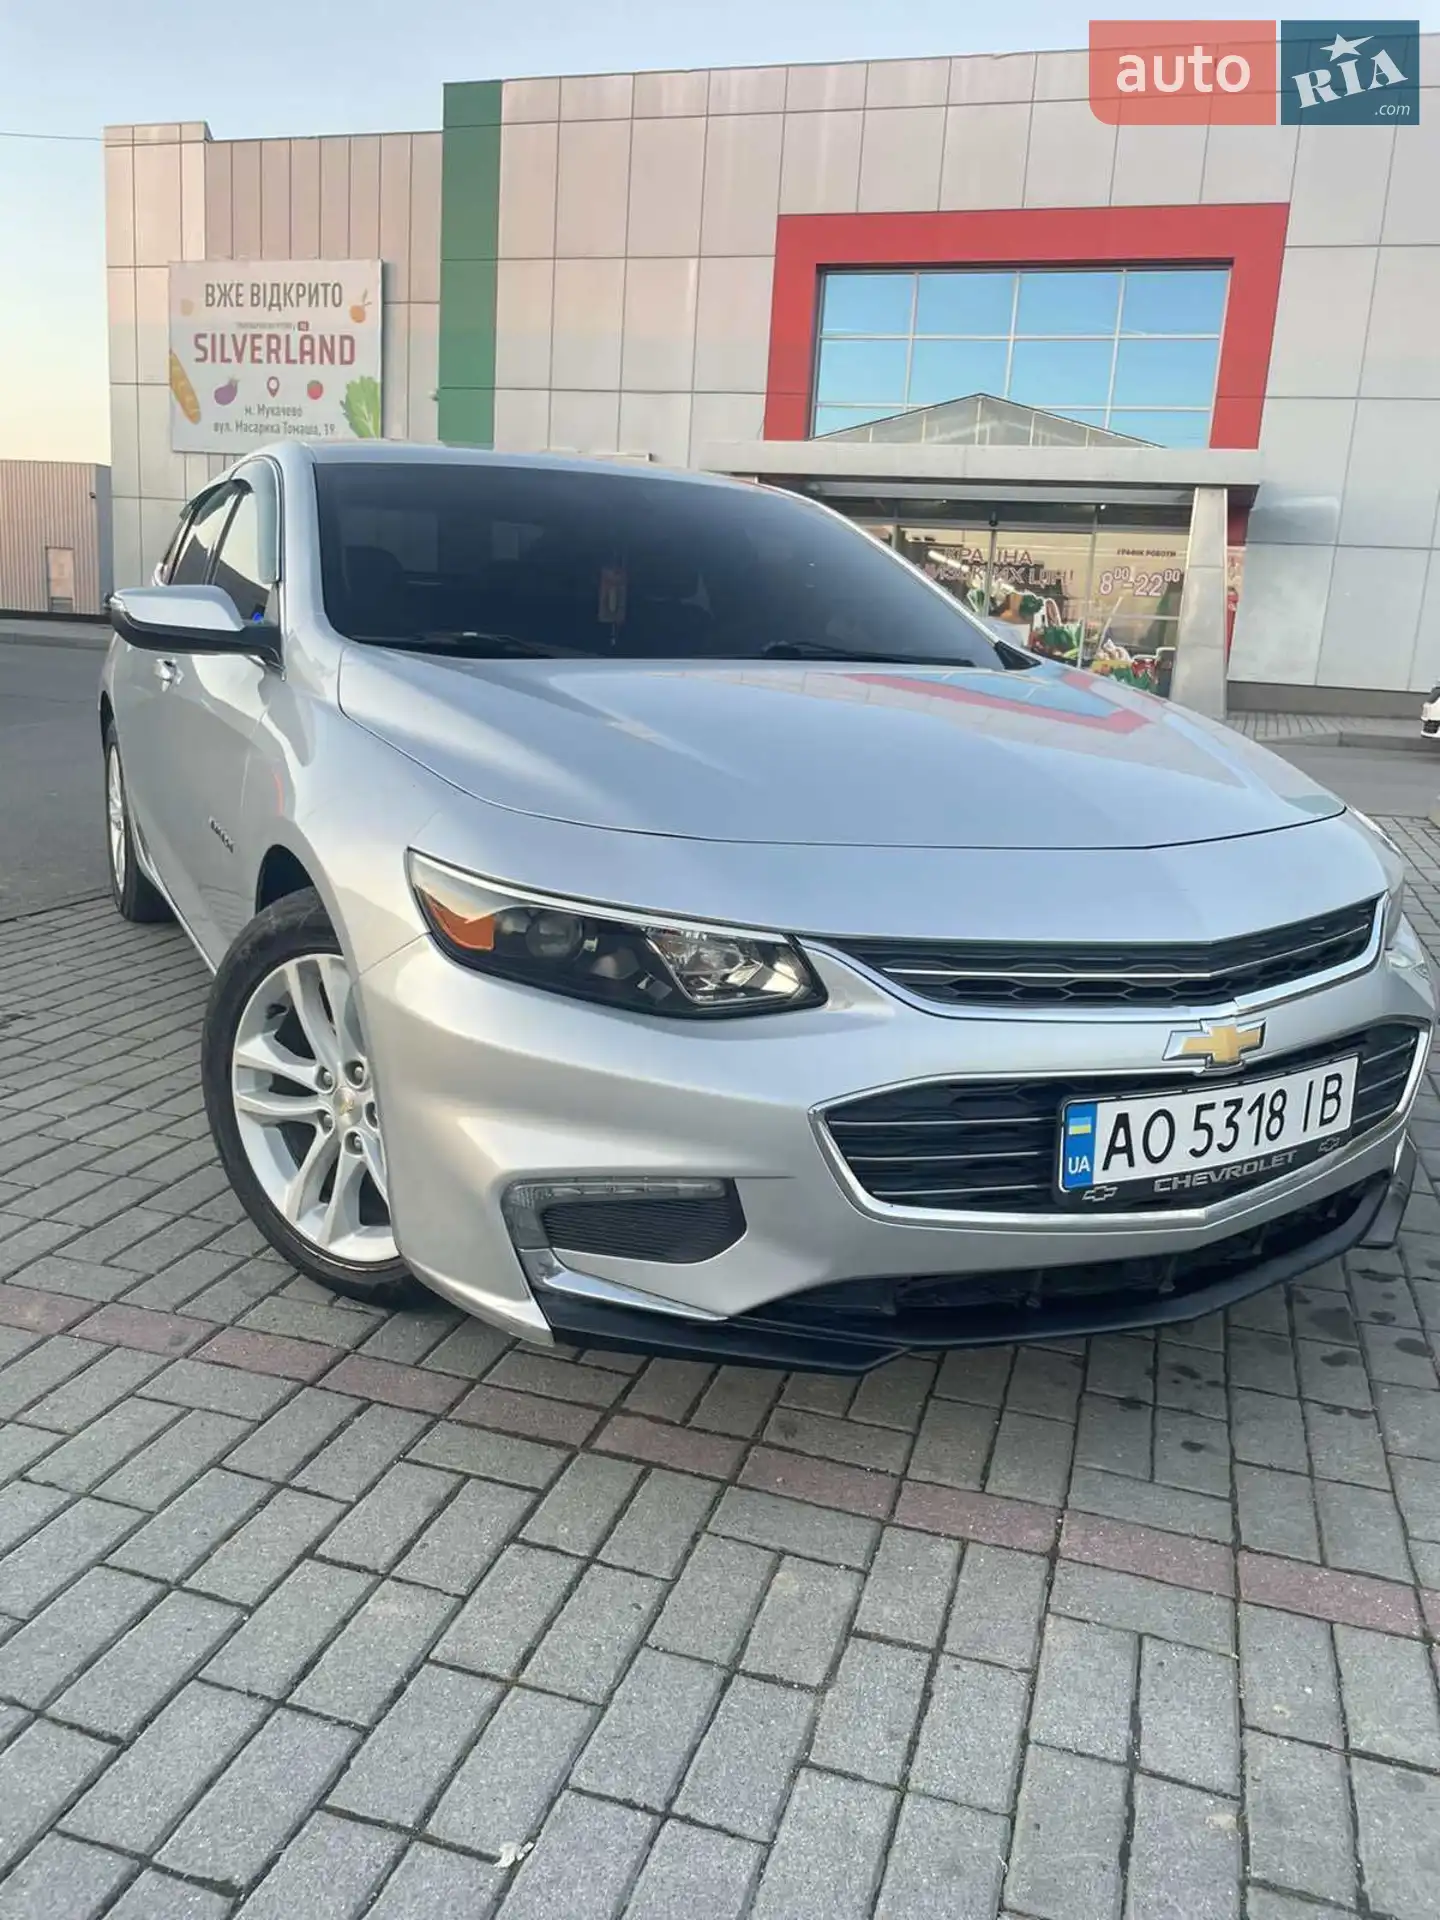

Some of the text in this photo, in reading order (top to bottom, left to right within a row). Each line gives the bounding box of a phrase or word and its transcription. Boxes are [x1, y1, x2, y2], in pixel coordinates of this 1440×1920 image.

[205, 282, 343, 311] ВЖЕ ВІДКРИТО
[193, 332, 356, 366] SILVERLAND
[1102, 1073, 1343, 1171] AO 5318 IB
[1068, 1155, 1091, 1175] UA
[1153, 1150, 1298, 1193] CHEVROLET
